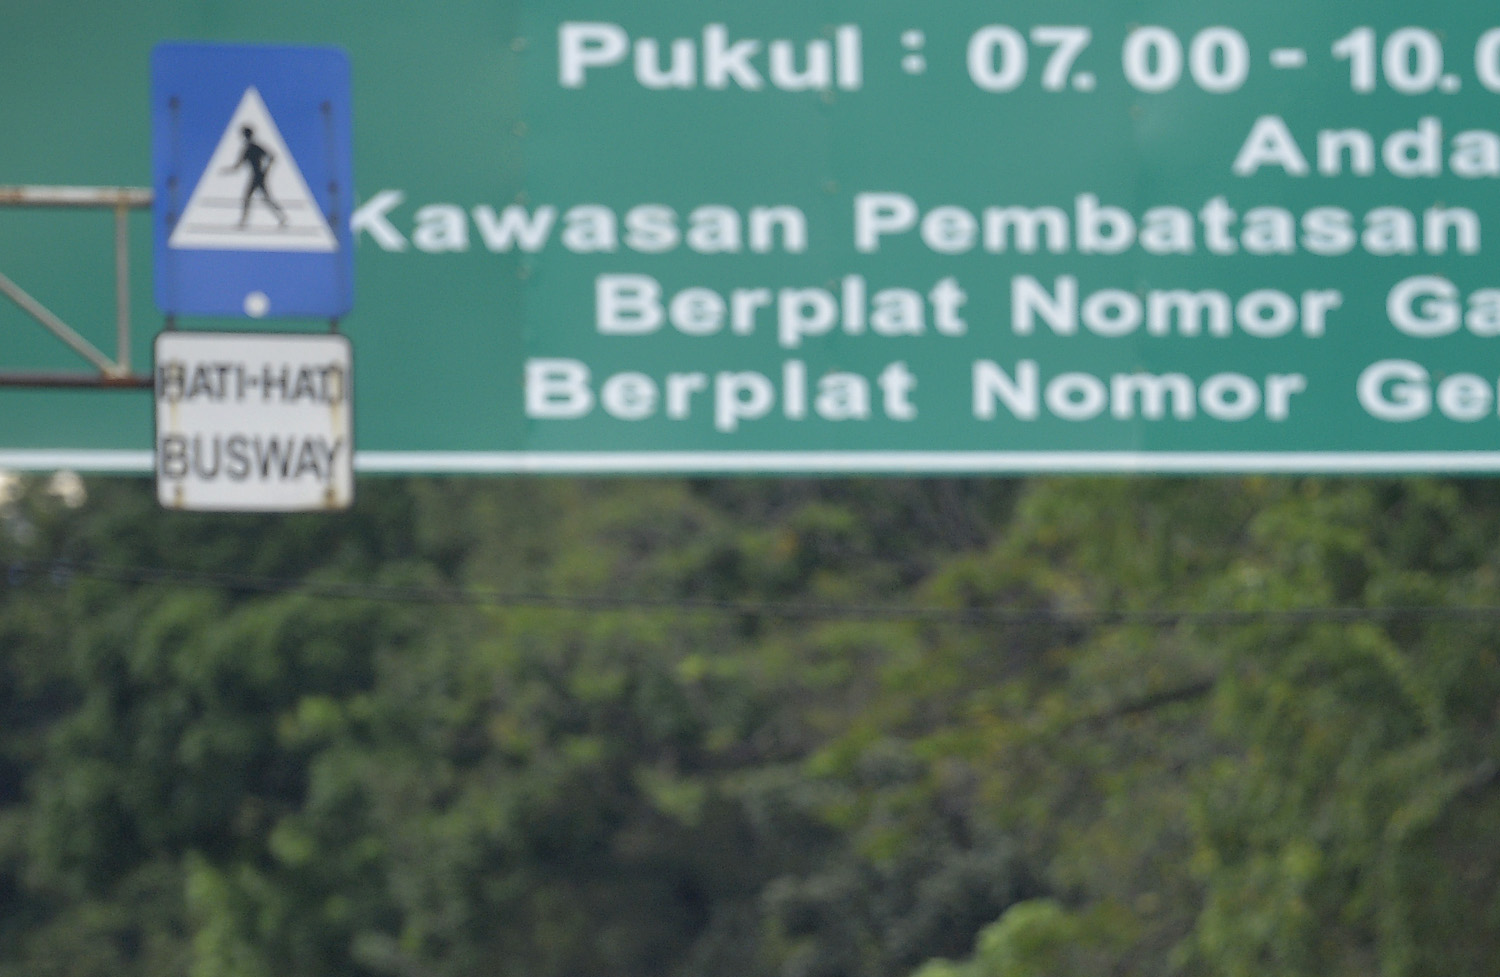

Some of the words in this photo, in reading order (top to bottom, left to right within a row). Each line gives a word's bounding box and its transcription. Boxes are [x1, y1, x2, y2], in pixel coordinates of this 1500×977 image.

[559, 22, 861, 90] Pukul
[353, 190, 806, 253] Kawasan
[854, 192, 1479, 255] Pembatasan
[596, 274, 965, 347] Berplat
[1011, 275, 1341, 338] Nomor
[525, 358, 914, 431] Berplat
[972, 359, 1304, 420] Nomor
[161, 434, 343, 480] BUSWAY
